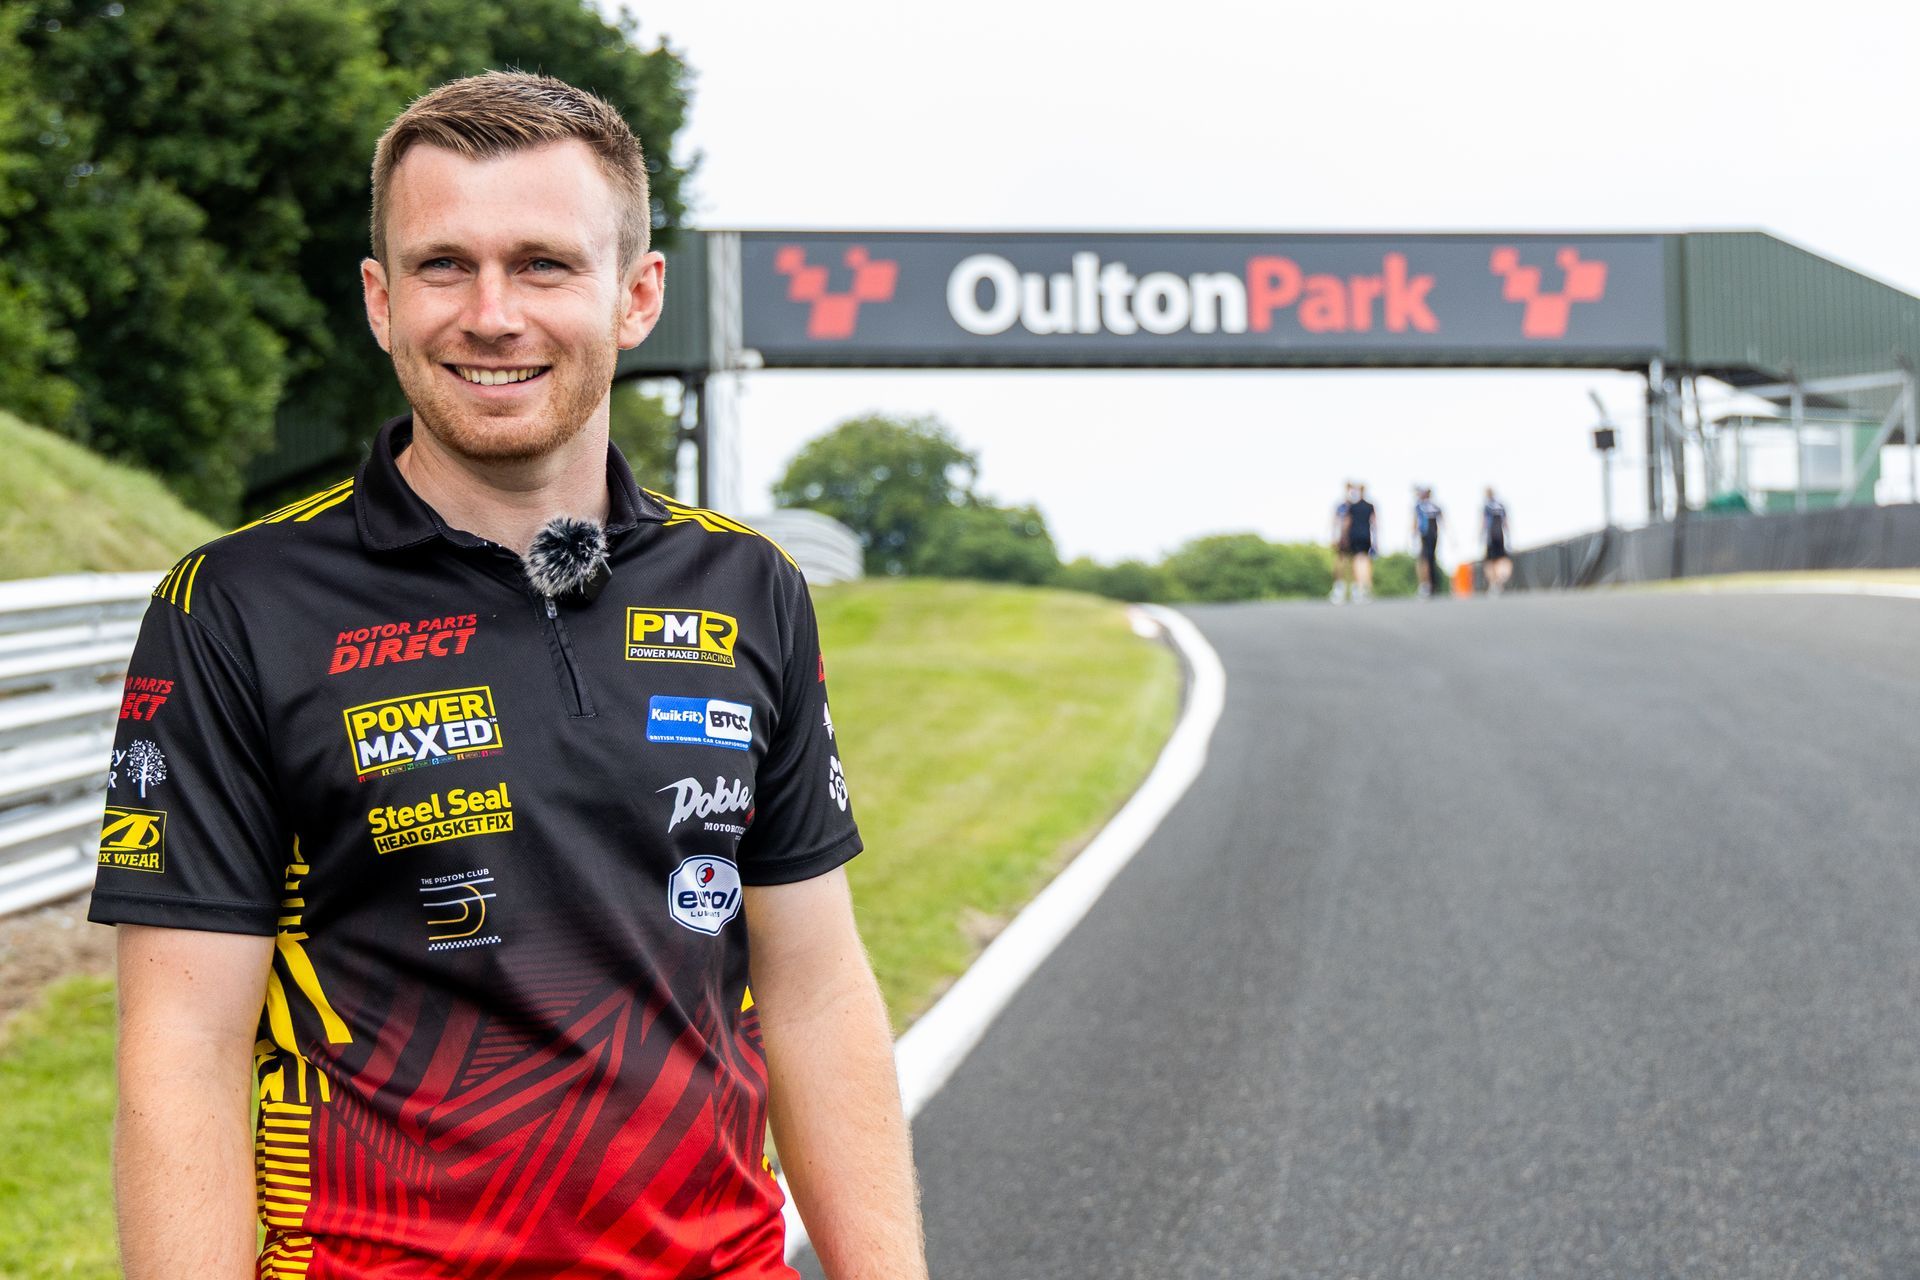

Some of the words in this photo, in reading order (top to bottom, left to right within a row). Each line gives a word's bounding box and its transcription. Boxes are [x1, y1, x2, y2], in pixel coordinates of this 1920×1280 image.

[337, 620, 411, 646] MOTOR
[417, 613, 478, 633] PARTS
[632, 612, 733, 651] PMR
[327, 627, 477, 675] DIRECT
[630, 648, 665, 659] POWER
[666, 649, 699, 660] MAXED
[700, 651, 732, 664] RACING
[132, 675, 174, 695] PARTS
[352, 693, 488, 740] POWER
[709, 710, 749, 732] BTCC
[675, 735, 702, 743] TOURING
[368, 793, 445, 834] Steel
[447, 782, 512, 815] Seal
[655, 775, 752, 834] Doble
[376, 830, 419, 852] HEAD
[420, 817, 483, 842] GASKET
[486, 813, 512, 831] FIX
[114, 852, 160, 869] WEAR
[434, 872, 465, 884] PISTON
[466, 867, 490, 878] CLUB
